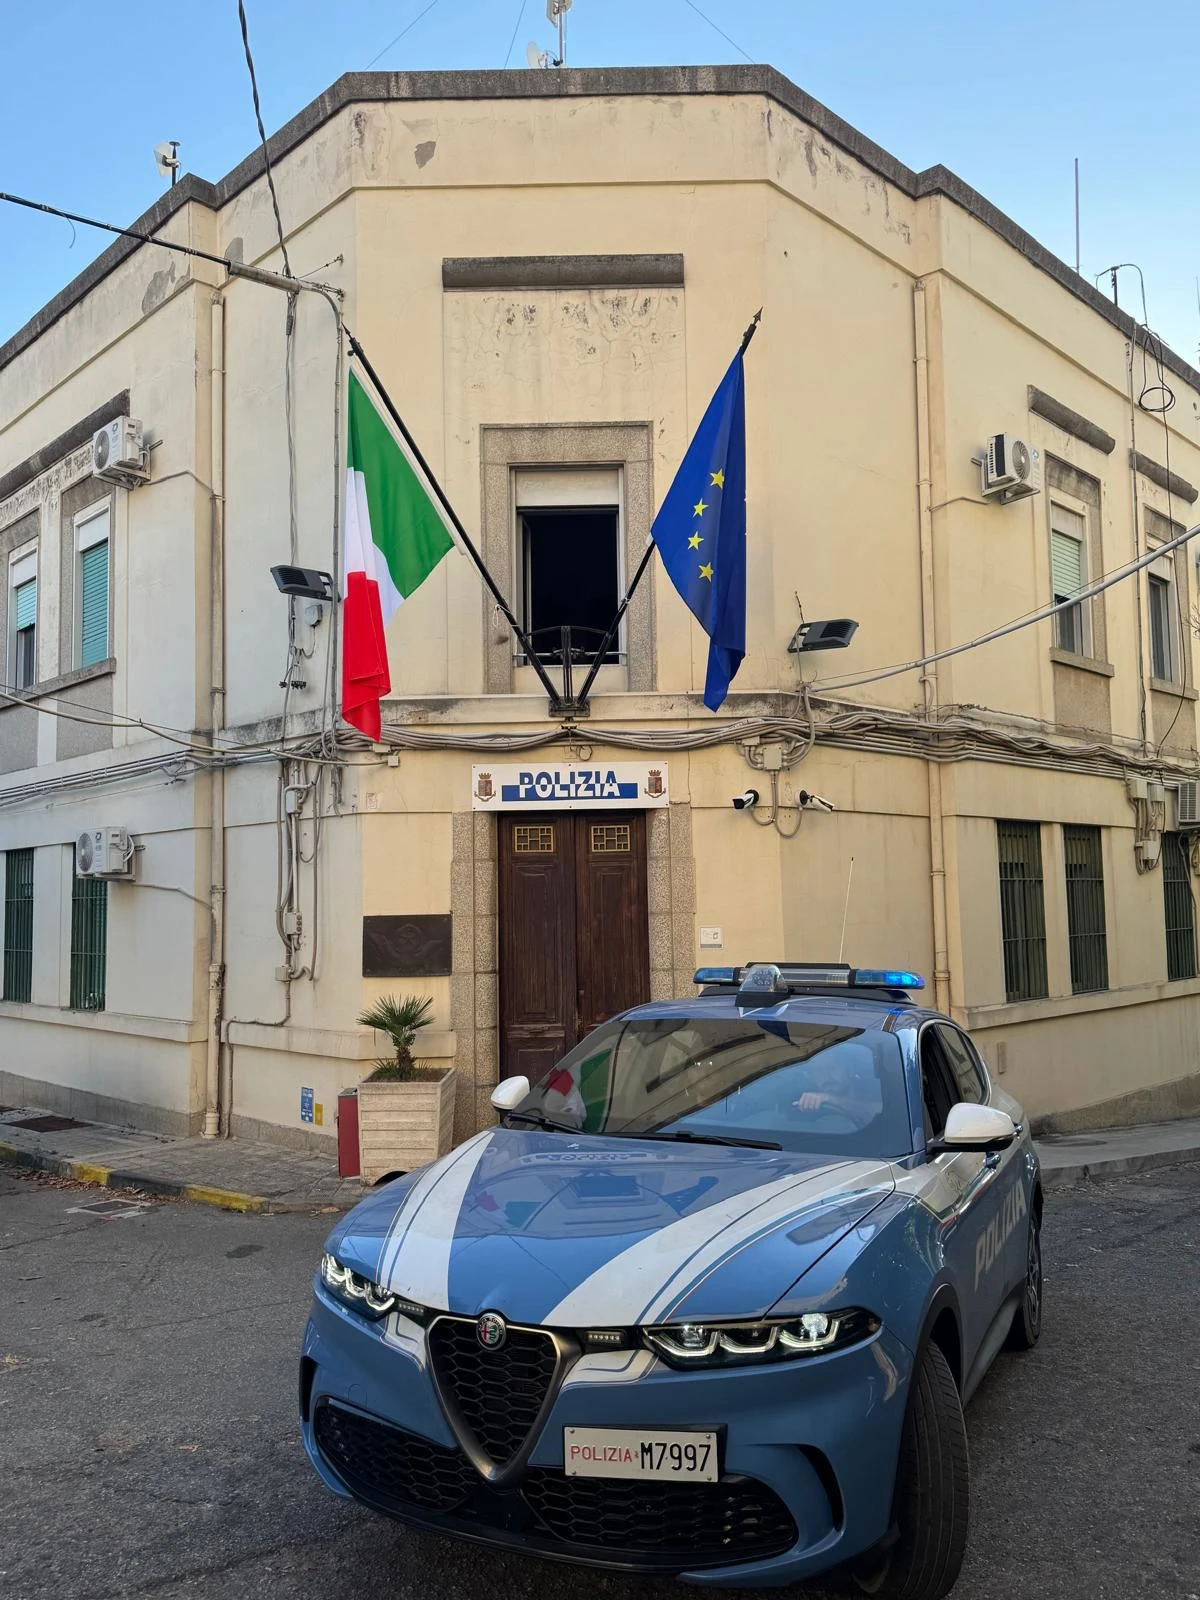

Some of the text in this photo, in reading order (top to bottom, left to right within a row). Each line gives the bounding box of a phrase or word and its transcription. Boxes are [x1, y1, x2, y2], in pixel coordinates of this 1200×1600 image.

[519, 770, 620, 799] POLIZIA
[974, 1176, 1027, 1293] POLIZIA
[570, 1442, 712, 1472] POLIZIA M7997
